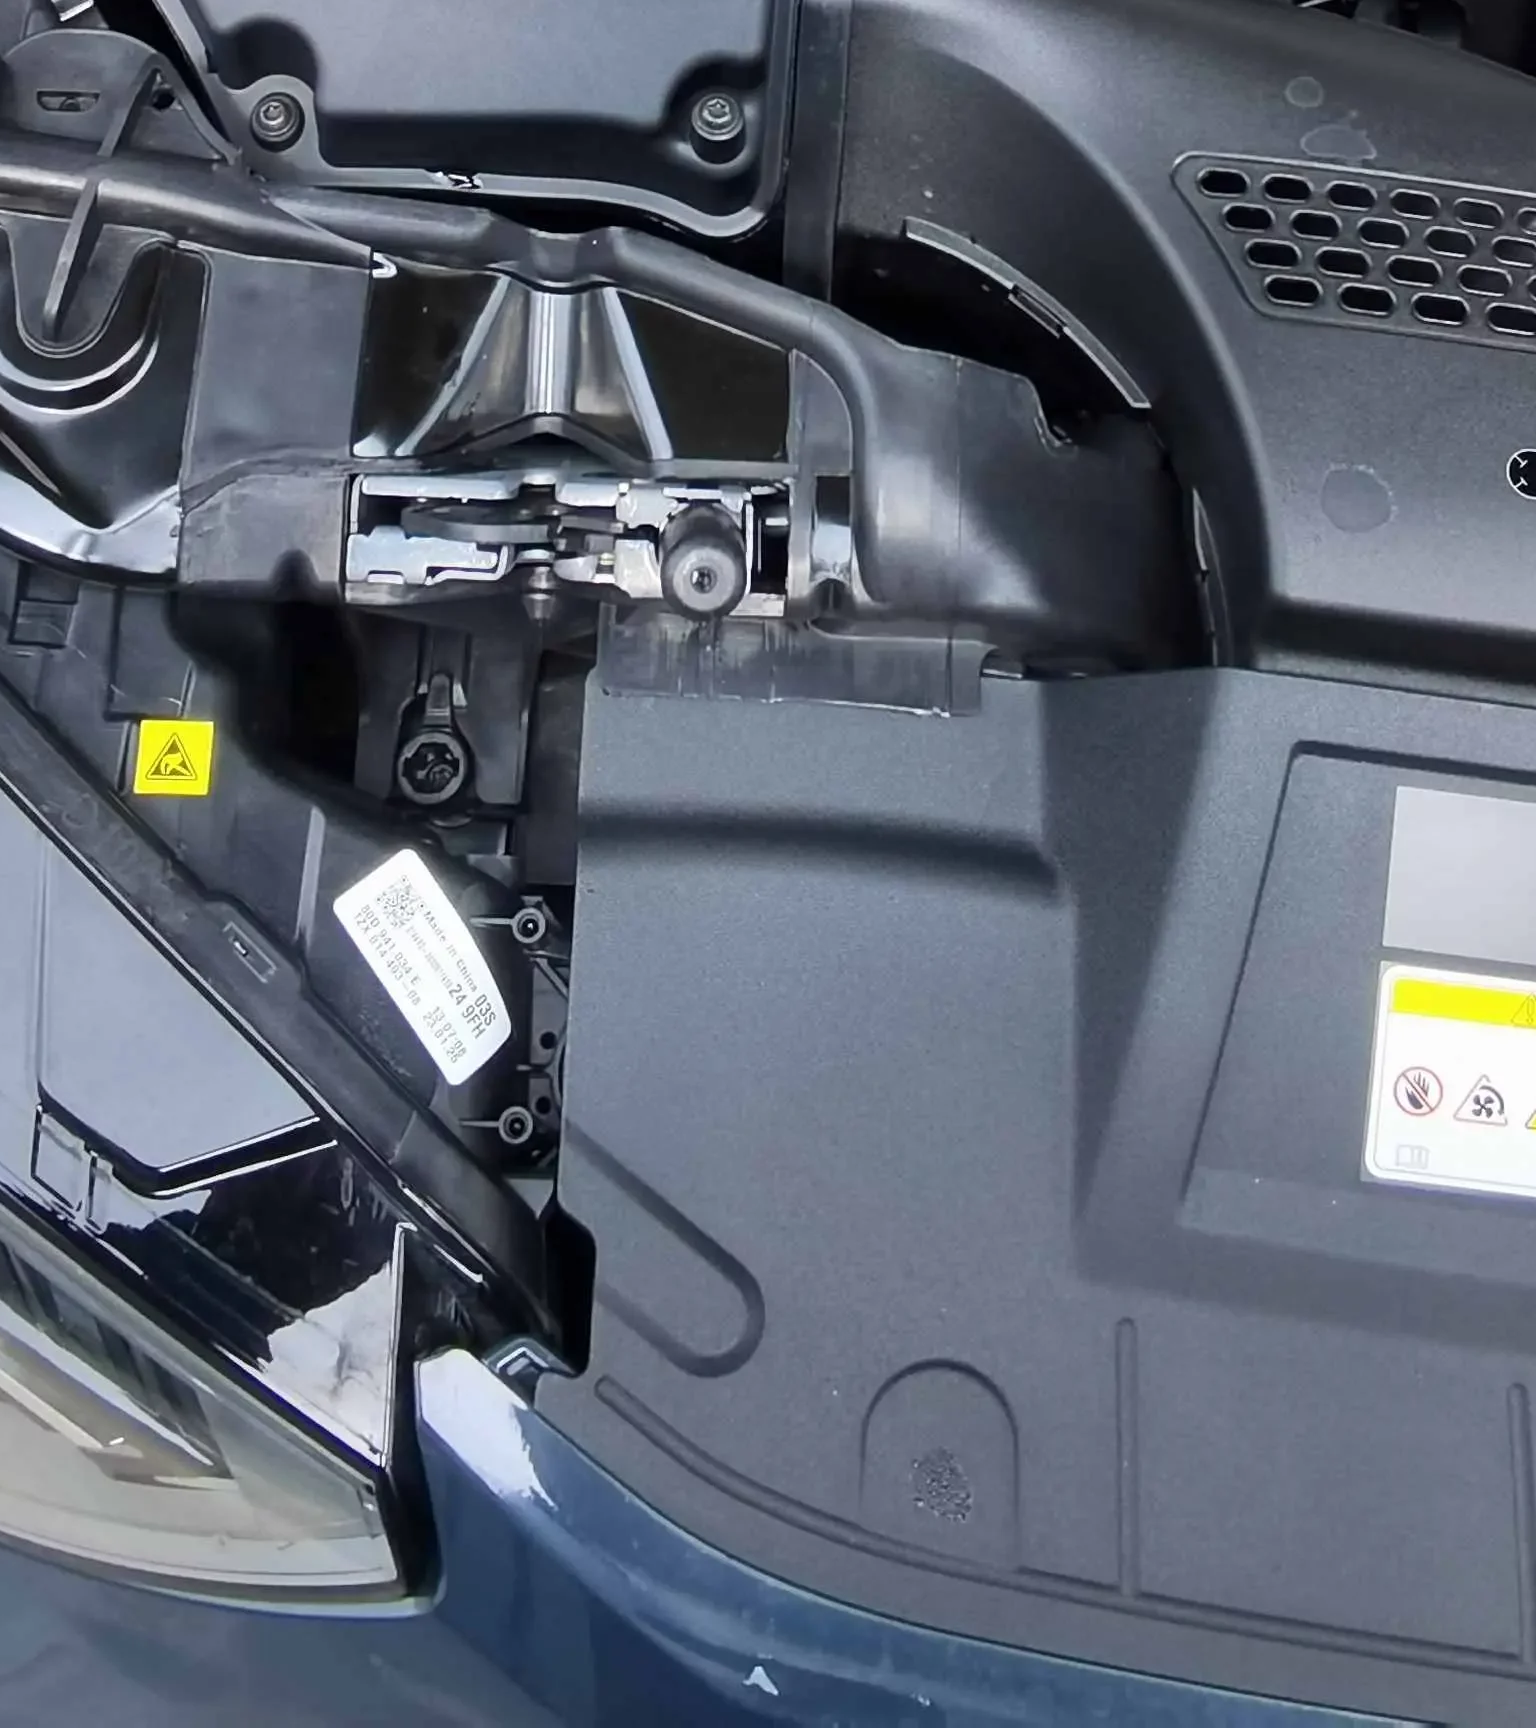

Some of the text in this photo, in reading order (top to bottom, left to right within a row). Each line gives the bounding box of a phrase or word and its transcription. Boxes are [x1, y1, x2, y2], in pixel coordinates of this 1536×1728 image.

[424, 911, 447, 942] Made
[456, 960, 478, 992] China
[474, 993, 496, 1026] 03S
[448, 984, 486, 1039] 24 9FH
